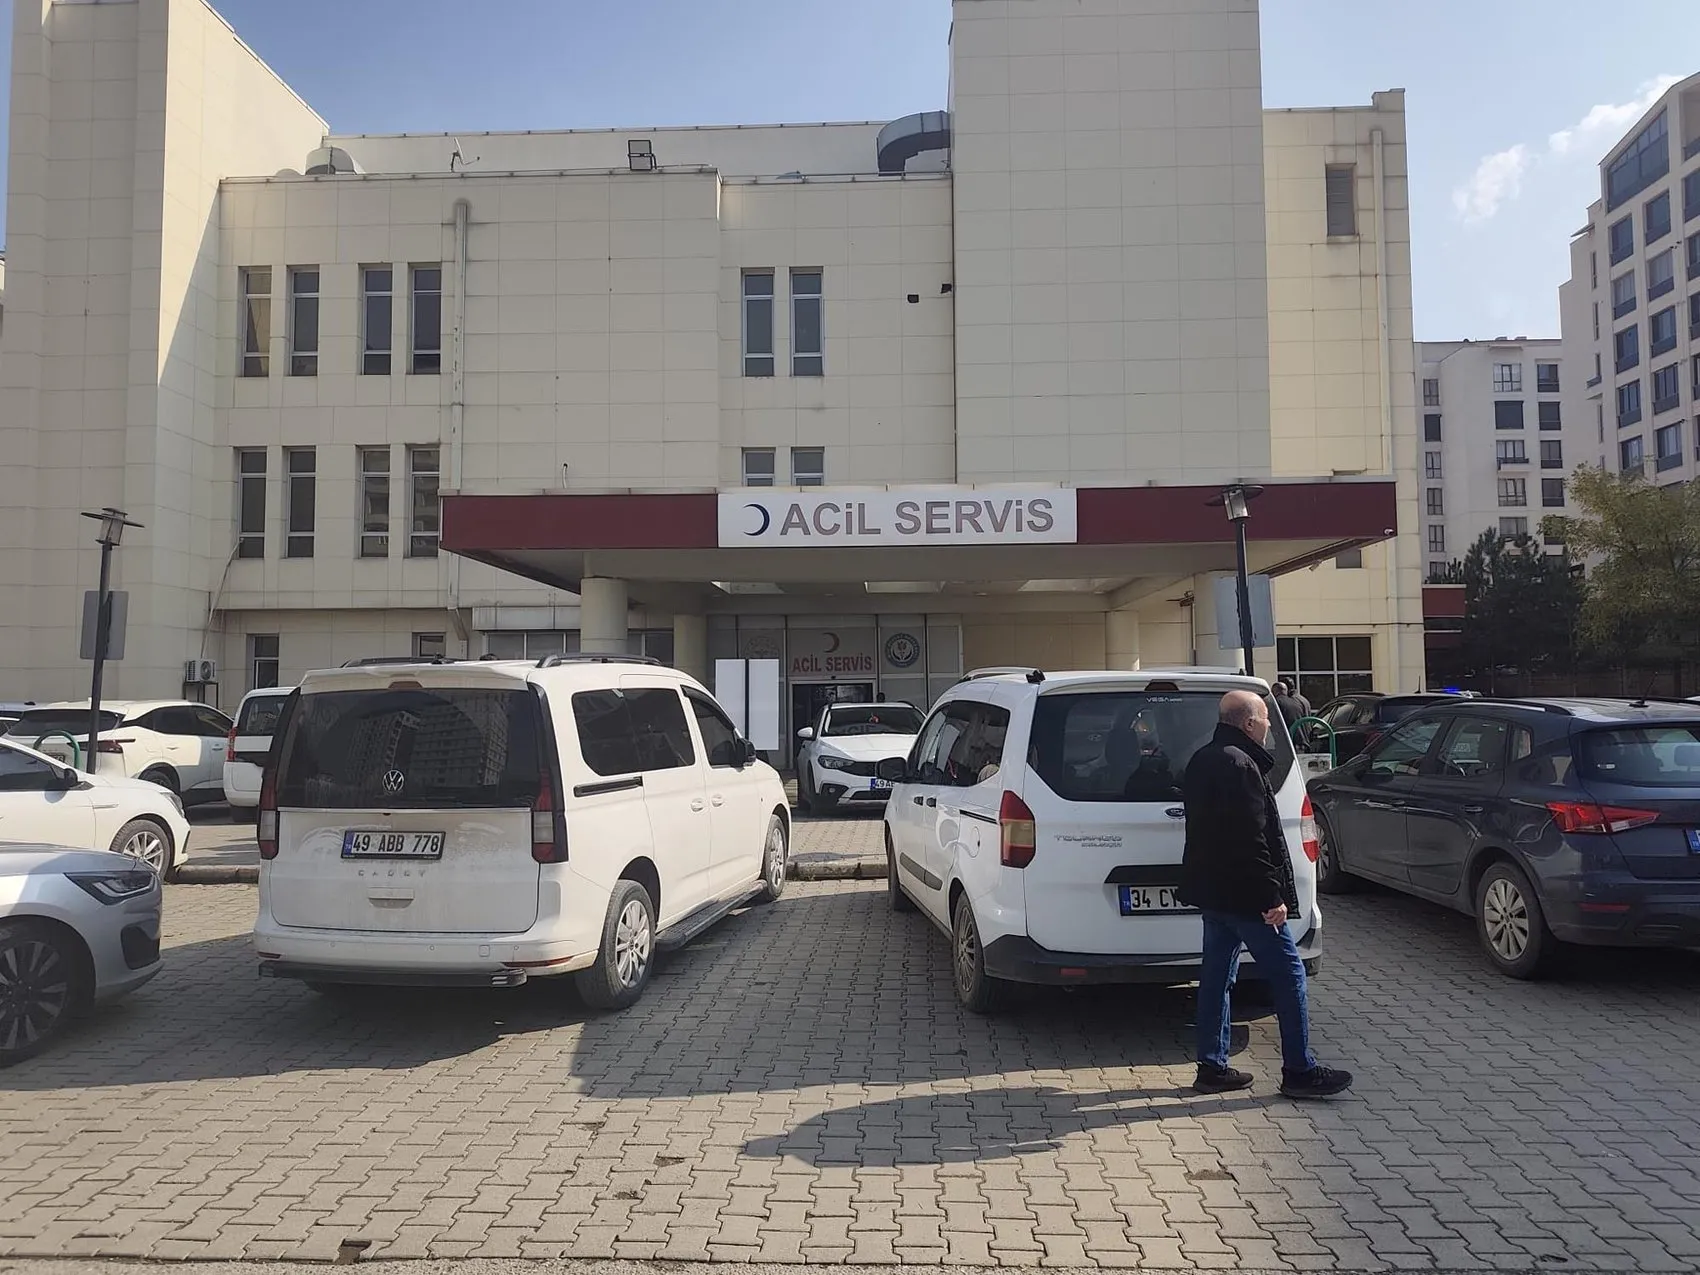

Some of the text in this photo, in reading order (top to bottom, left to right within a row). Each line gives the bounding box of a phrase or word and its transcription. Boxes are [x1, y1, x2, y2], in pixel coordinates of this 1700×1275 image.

[792, 653, 872, 672] ACİL SERVİS
[353, 834, 370, 852] 49
[378, 834, 405, 852] ABB
[412, 834, 440, 852] 778
[1131, 888, 1151, 908] 34
